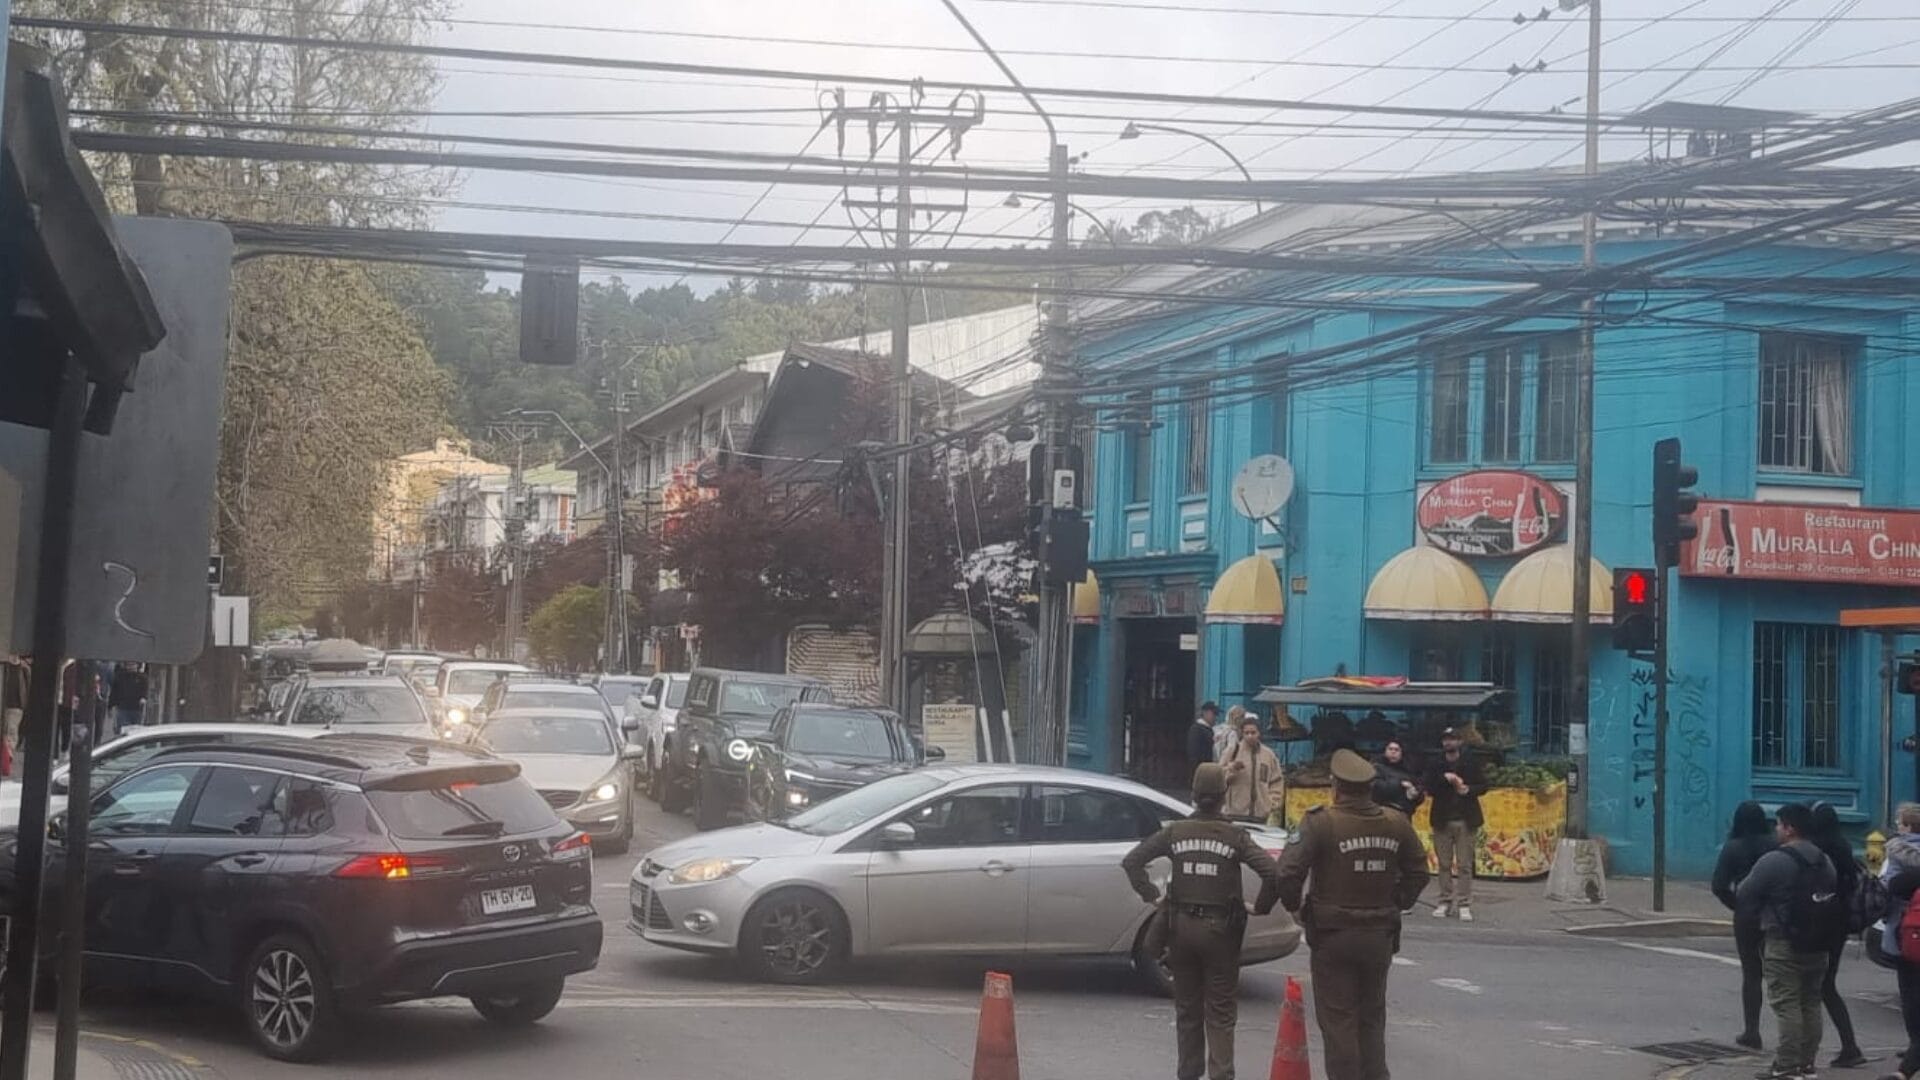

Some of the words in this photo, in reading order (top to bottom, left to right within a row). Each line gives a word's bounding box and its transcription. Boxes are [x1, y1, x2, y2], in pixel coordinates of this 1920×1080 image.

[1804, 511, 1887, 530] Restaurant
[1752, 527, 1855, 556] MURALLA
[1183, 862, 1194, 874] DE
[1195, 863, 1218, 876] CHILE
[1354, 860, 1365, 871] DE
[1367, 860, 1386, 871] CHILE
